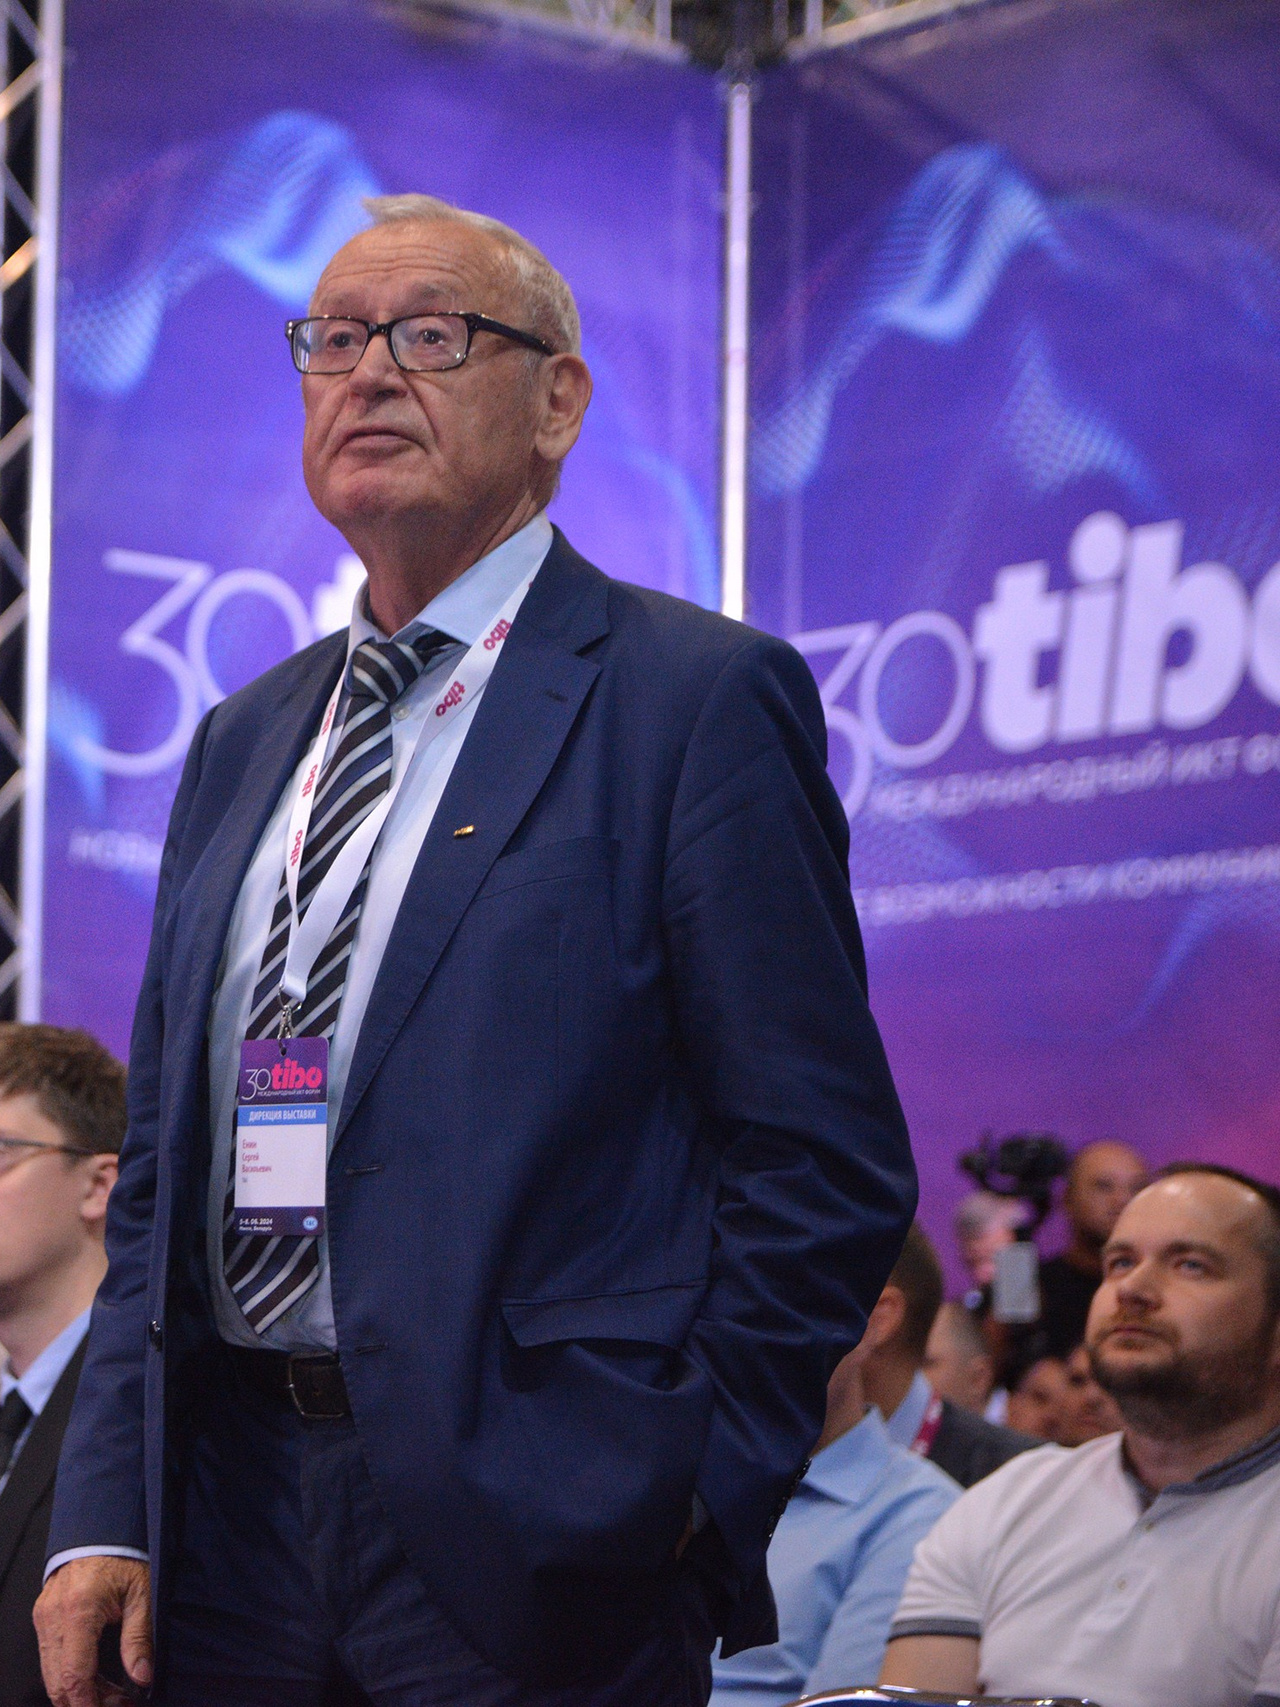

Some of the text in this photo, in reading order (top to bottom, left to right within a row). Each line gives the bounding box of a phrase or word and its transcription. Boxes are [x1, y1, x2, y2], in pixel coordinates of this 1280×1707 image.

[435, 680, 466, 717] tibo
[302, 763, 318, 798] tibo
[290, 829, 303, 866] tibo
[241, 1057, 322, 1100] 30 tibo
[248, 1109, 317, 1122] ДИРЕКЦИЯ ВЫСТАВКИ
[242, 1151, 259, 1162] Сергей
